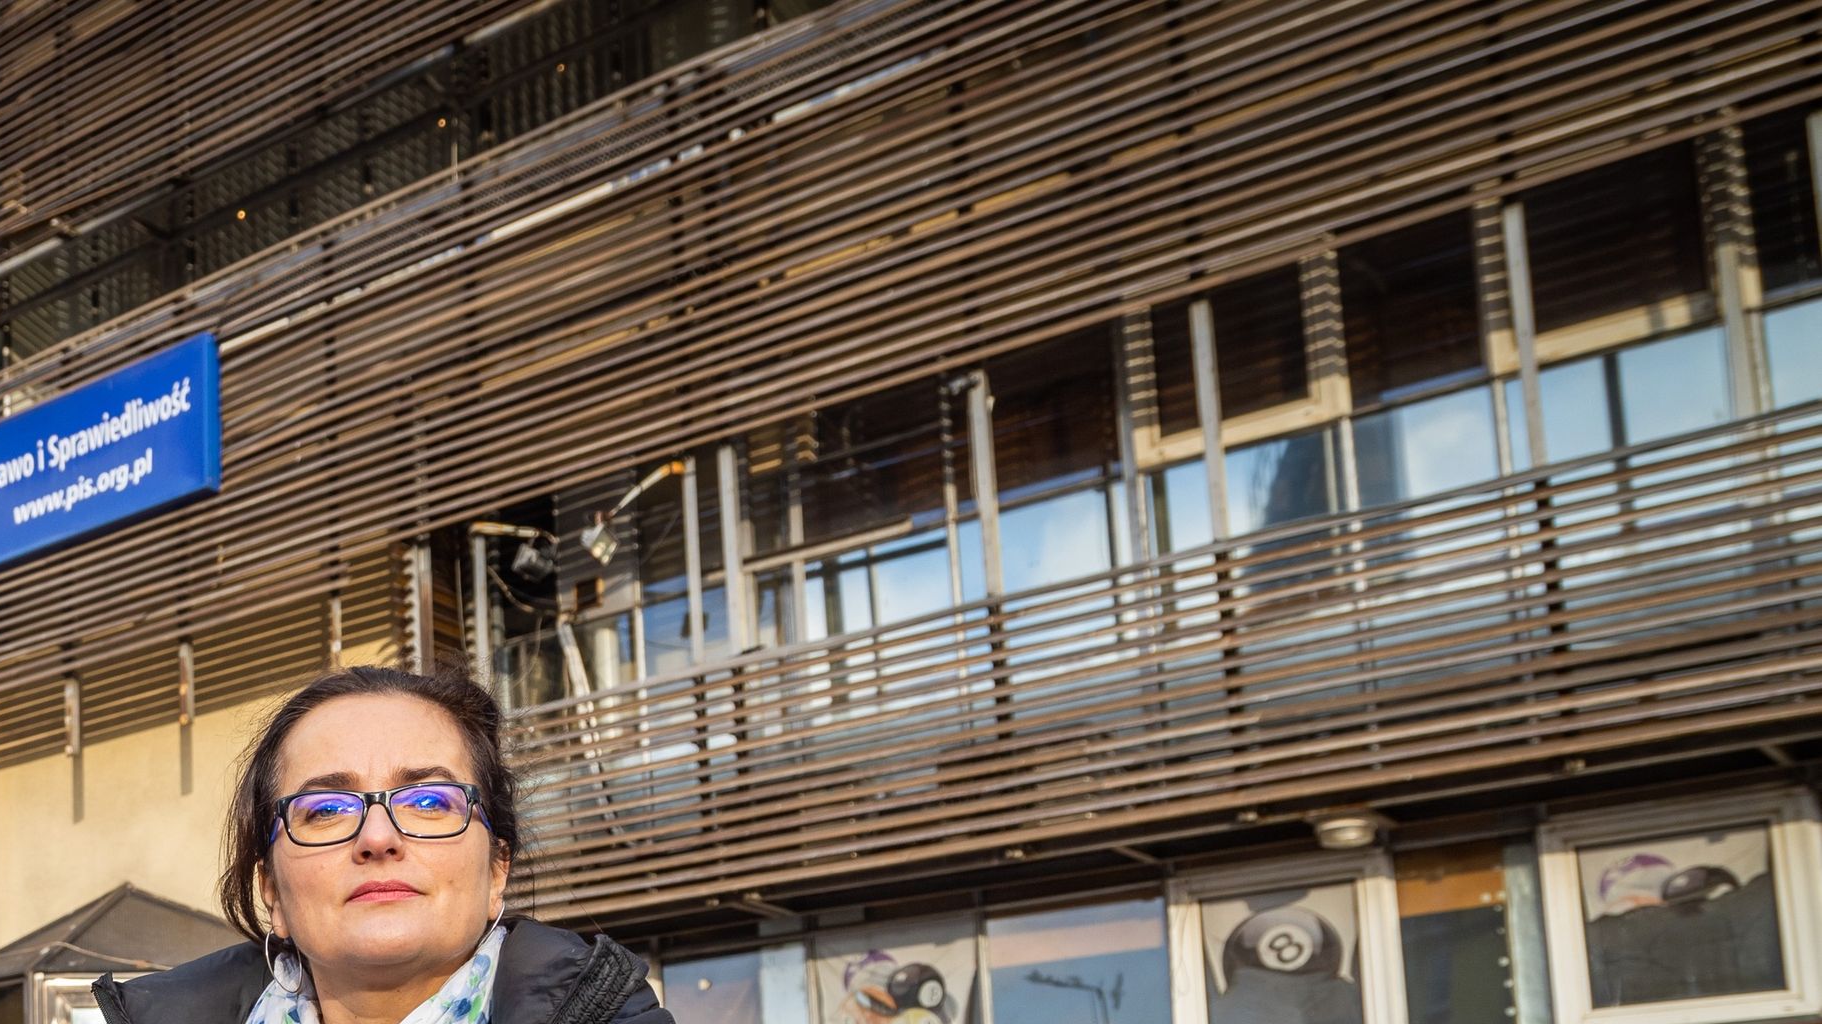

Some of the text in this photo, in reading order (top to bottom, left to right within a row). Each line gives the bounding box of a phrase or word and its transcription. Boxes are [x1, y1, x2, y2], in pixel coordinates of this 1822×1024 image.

[37, 440, 45, 471] i
[47, 377, 191, 471] Sprawiedliwość
[13, 447, 153, 525] www.pis.org.pl
